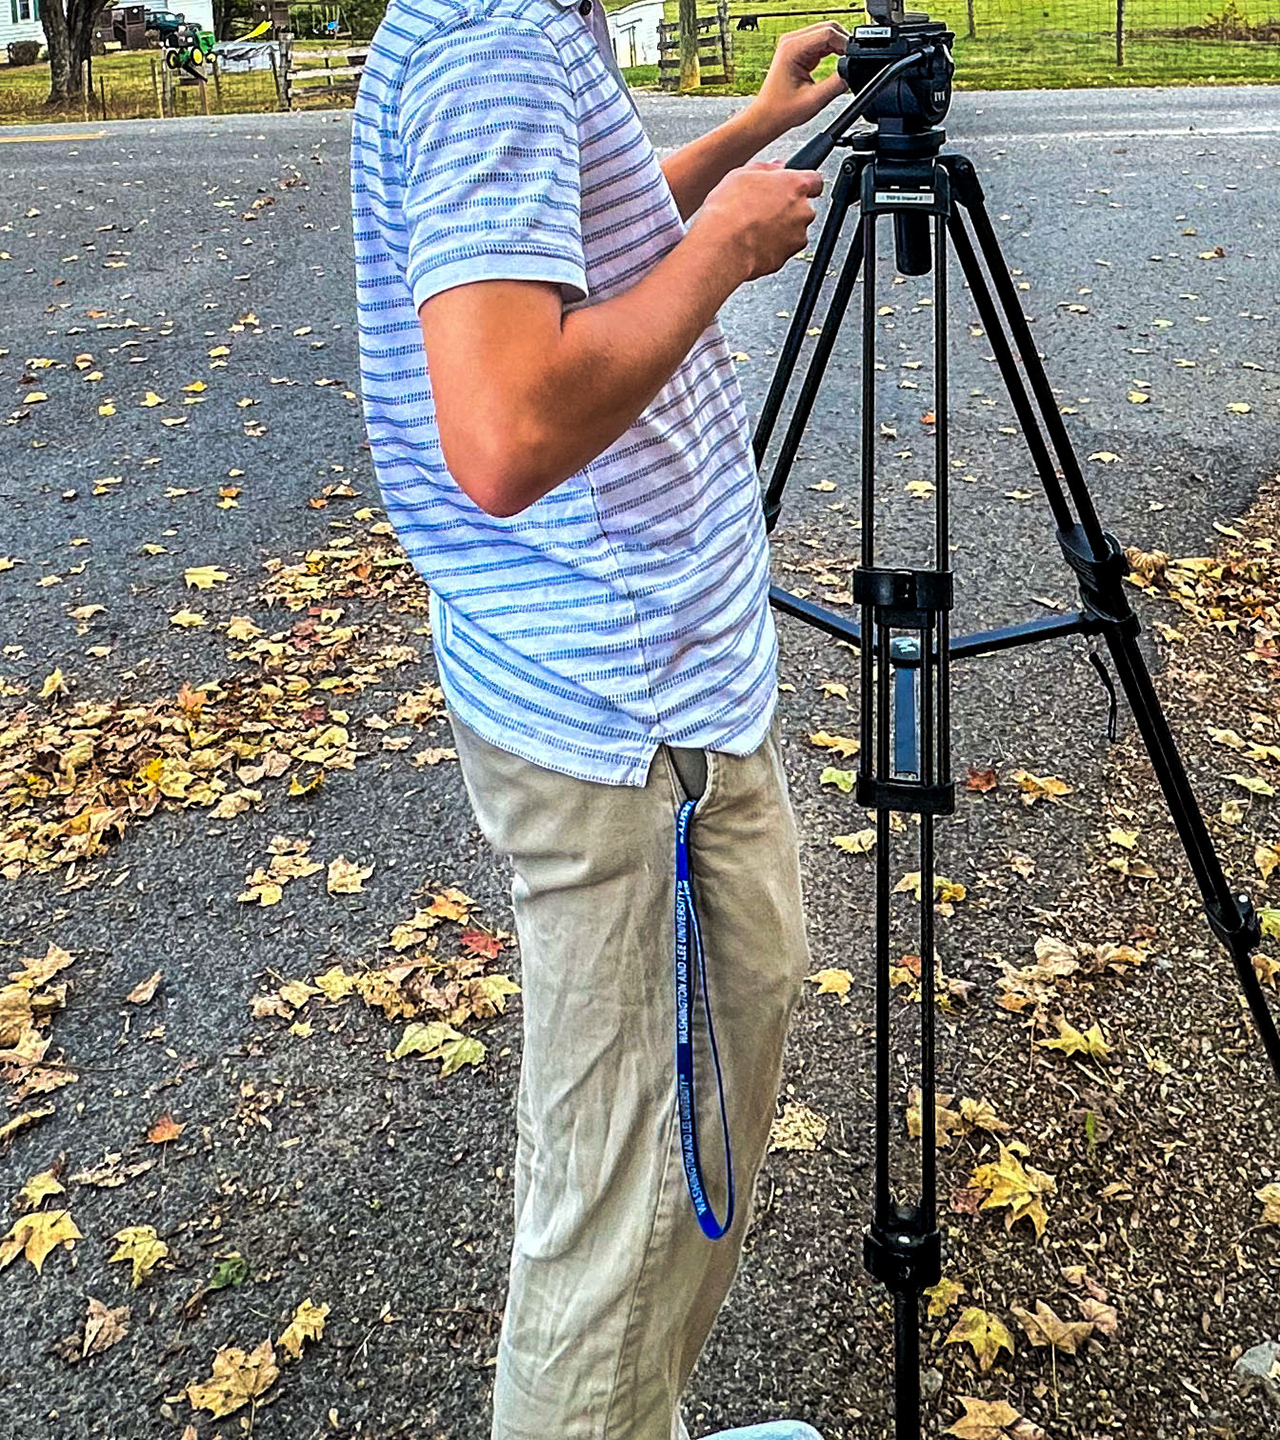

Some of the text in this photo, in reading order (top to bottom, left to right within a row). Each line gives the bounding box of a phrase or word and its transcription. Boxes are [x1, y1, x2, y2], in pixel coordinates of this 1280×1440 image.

[677, 944, 687, 961] LEE
[677, 962, 687, 982] AND
[678, 983, 689, 1044] WASHINGTON
[681, 1120, 692, 1133] LEE
[683, 1134, 694, 1152] AND
[685, 1152, 707, 1216] WASHINGTON
